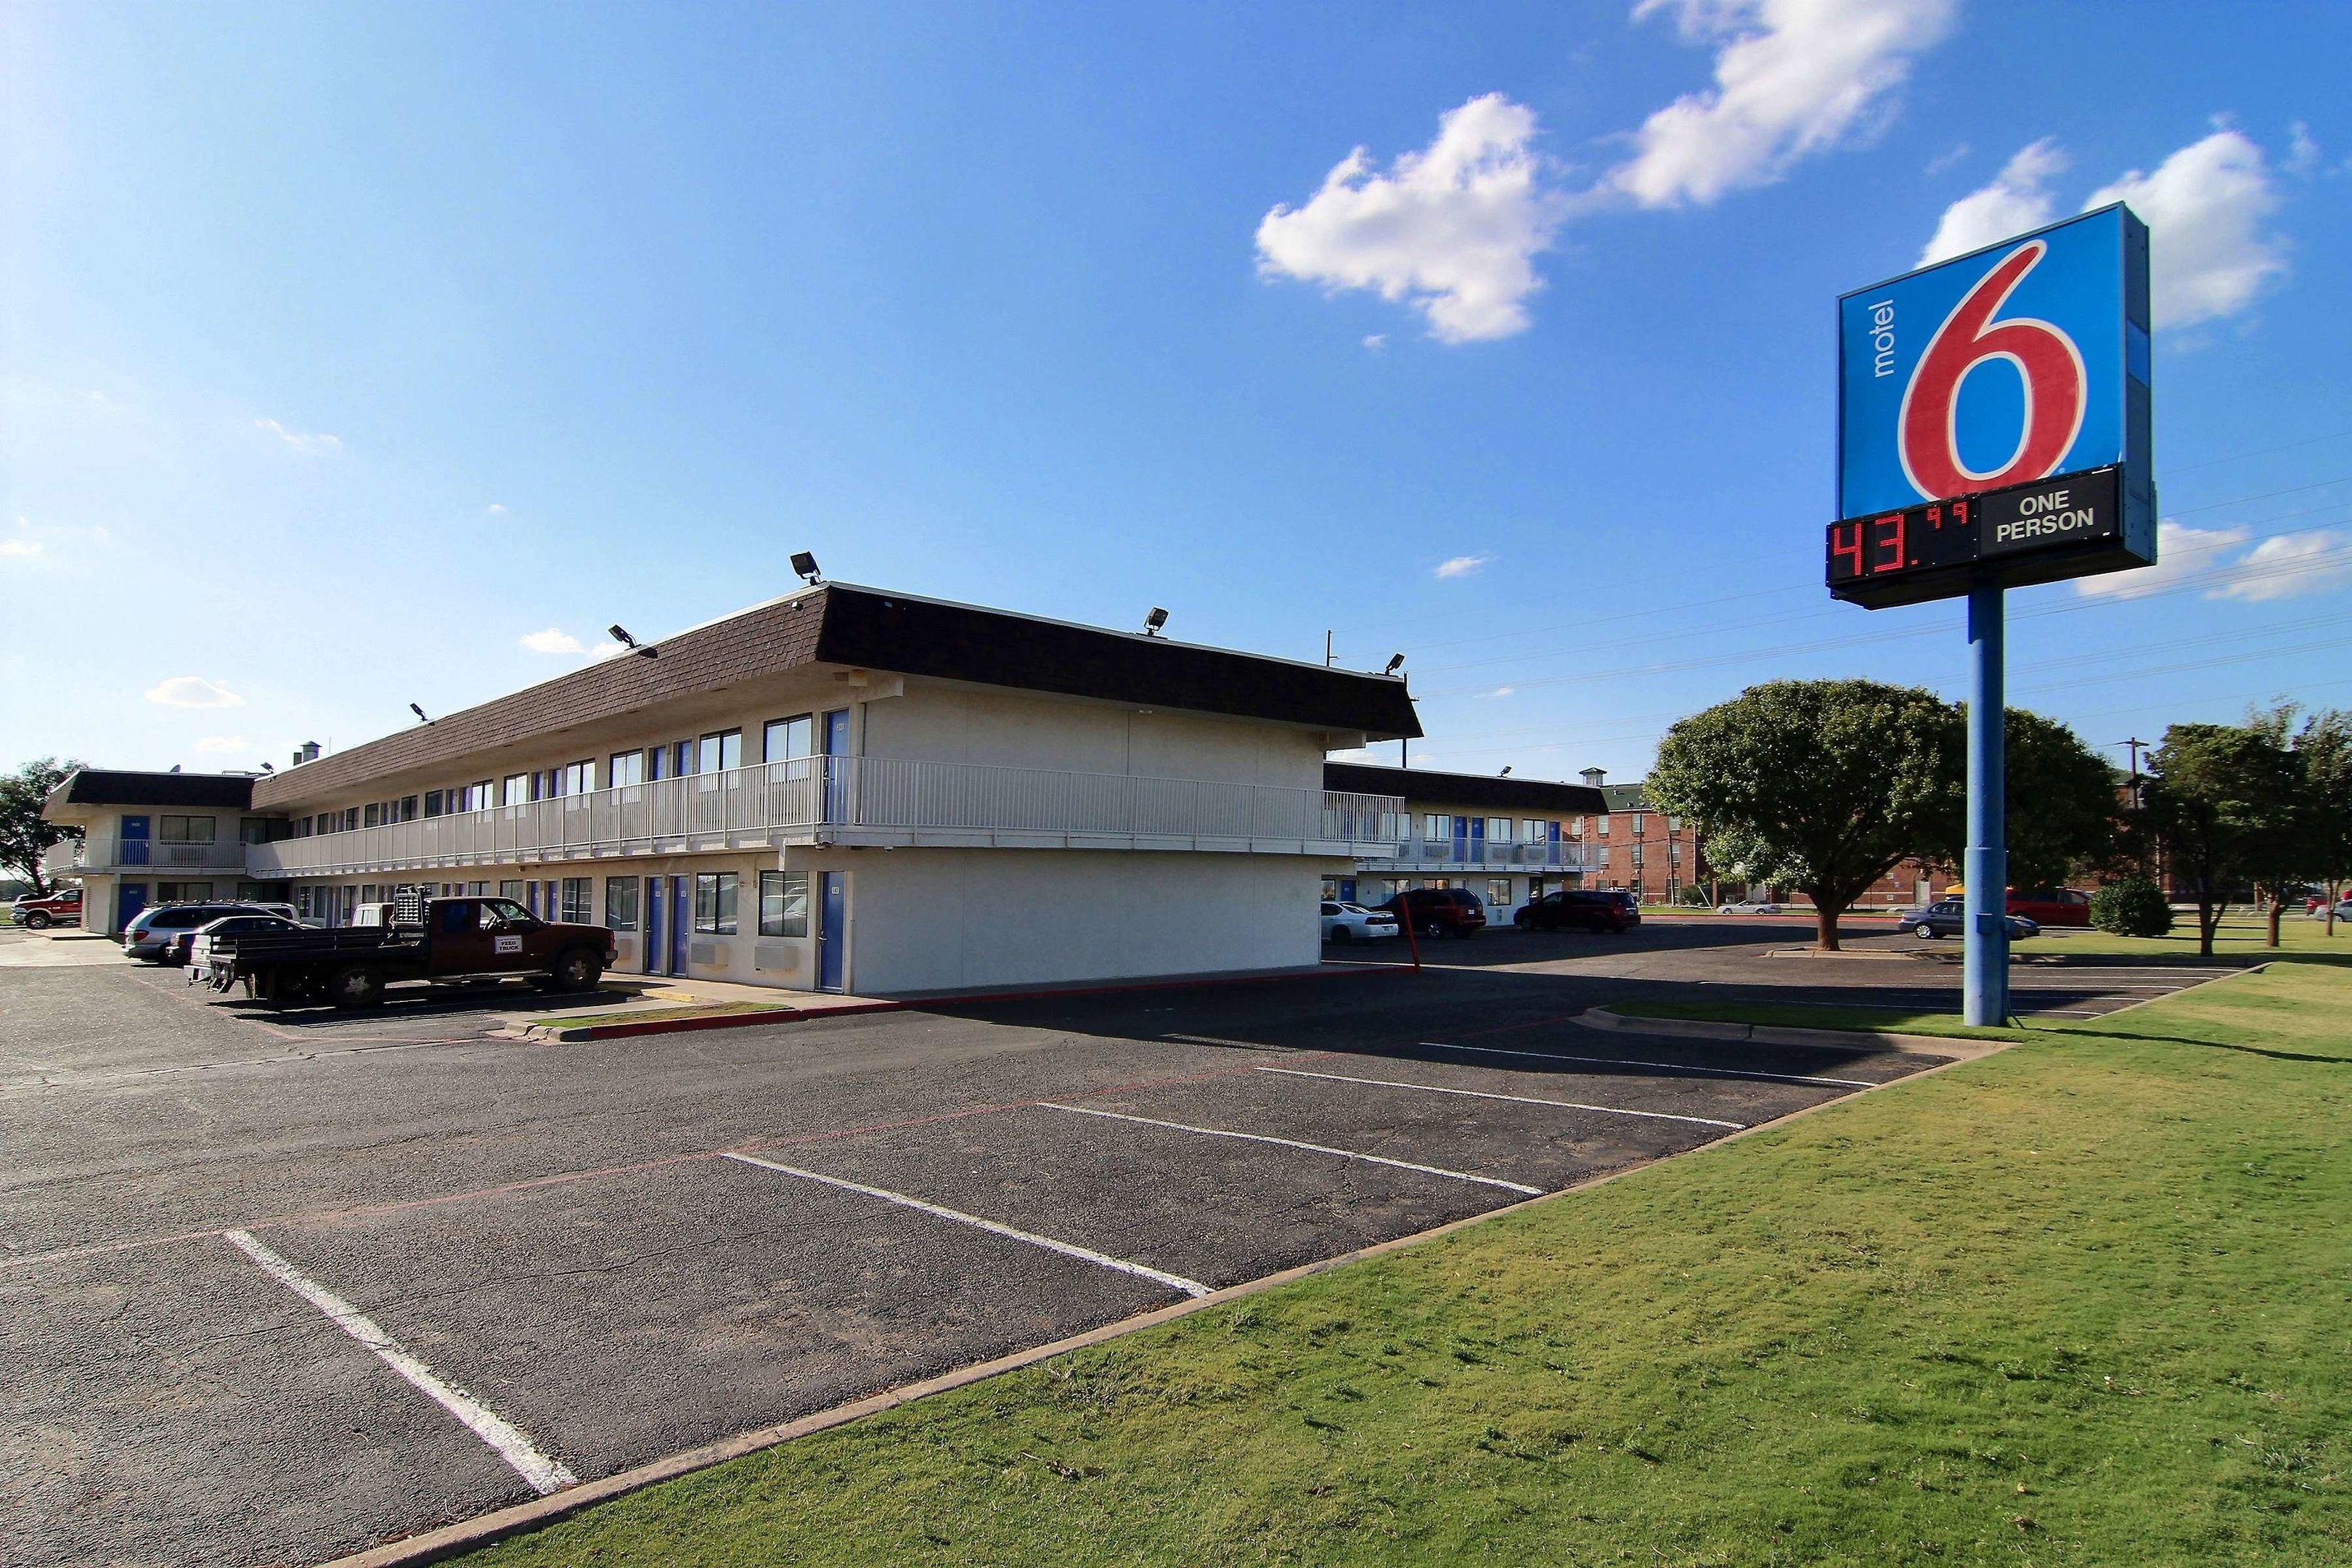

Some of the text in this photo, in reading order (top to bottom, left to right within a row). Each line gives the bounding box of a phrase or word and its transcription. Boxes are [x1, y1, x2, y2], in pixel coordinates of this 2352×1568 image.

[1868, 238, 2087, 502] motel 6
[2019, 489, 2070, 516] ONE
[1996, 507, 2094, 542] PERSON
